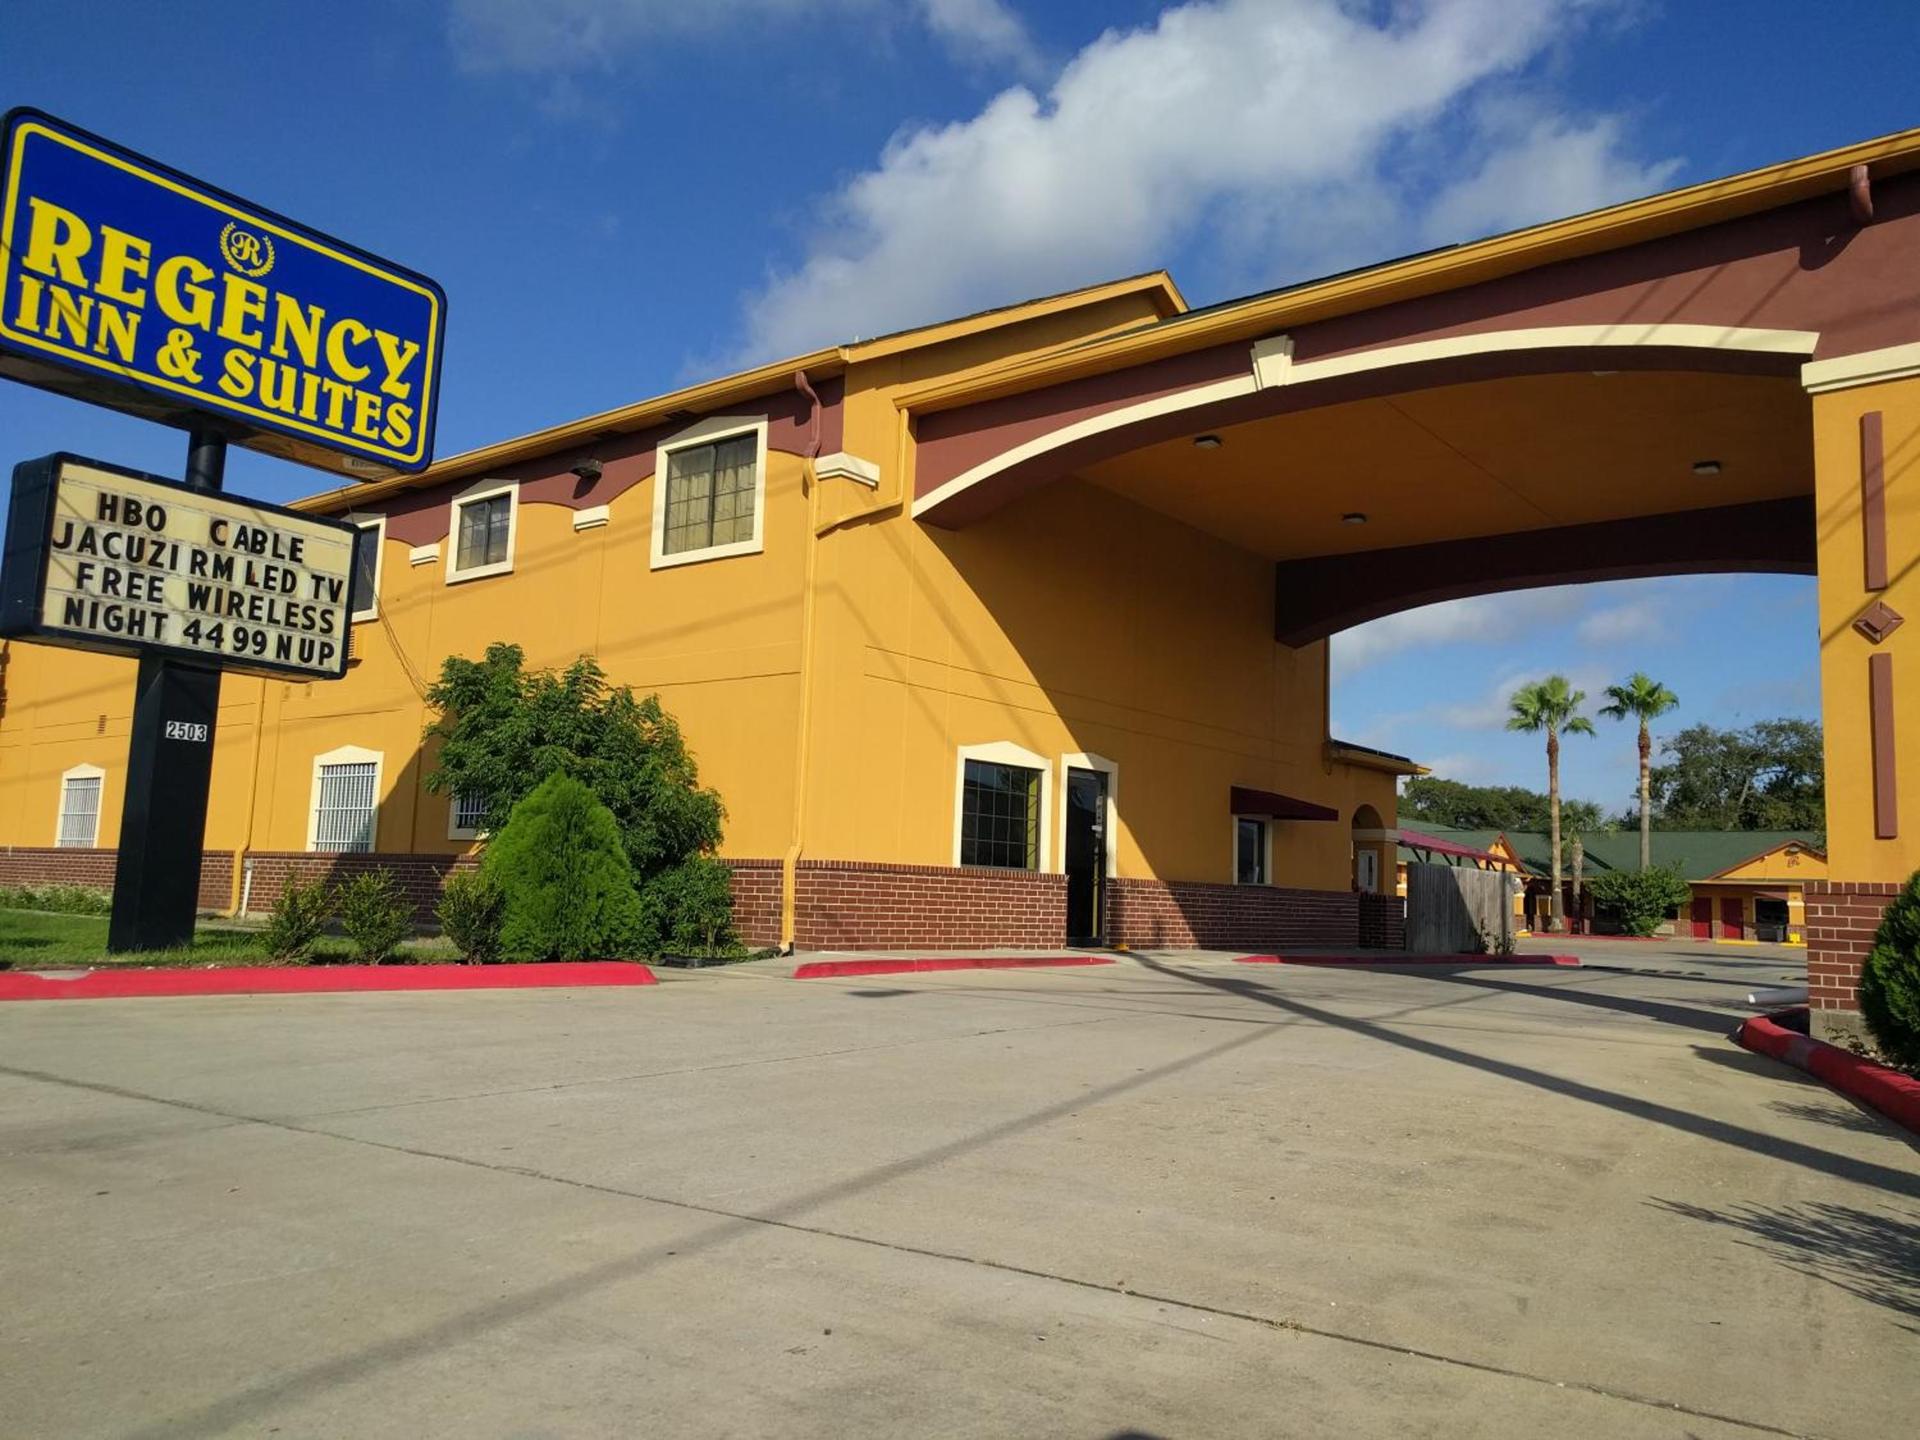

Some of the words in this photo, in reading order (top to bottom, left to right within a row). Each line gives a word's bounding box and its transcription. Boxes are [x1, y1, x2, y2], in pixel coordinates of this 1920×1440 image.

[22, 196, 420, 399] REGENCY
[15, 274, 140, 363] INN
[156, 328, 203, 384] &
[218, 349, 413, 448] SUITES
[52, 522, 179, 570] JACUZI
[190, 549, 235, 582] RM
[245, 560, 297, 594] LED
[311, 574, 344, 603] TV
[98, 492, 166, 532] HBO
[210, 520, 304, 564] CABLE
[63, 597, 168, 639] NIGHT
[76, 561, 164, 603] FREE
[188, 582, 334, 634] WIRELESS
[168, 722, 206, 740] 2503
